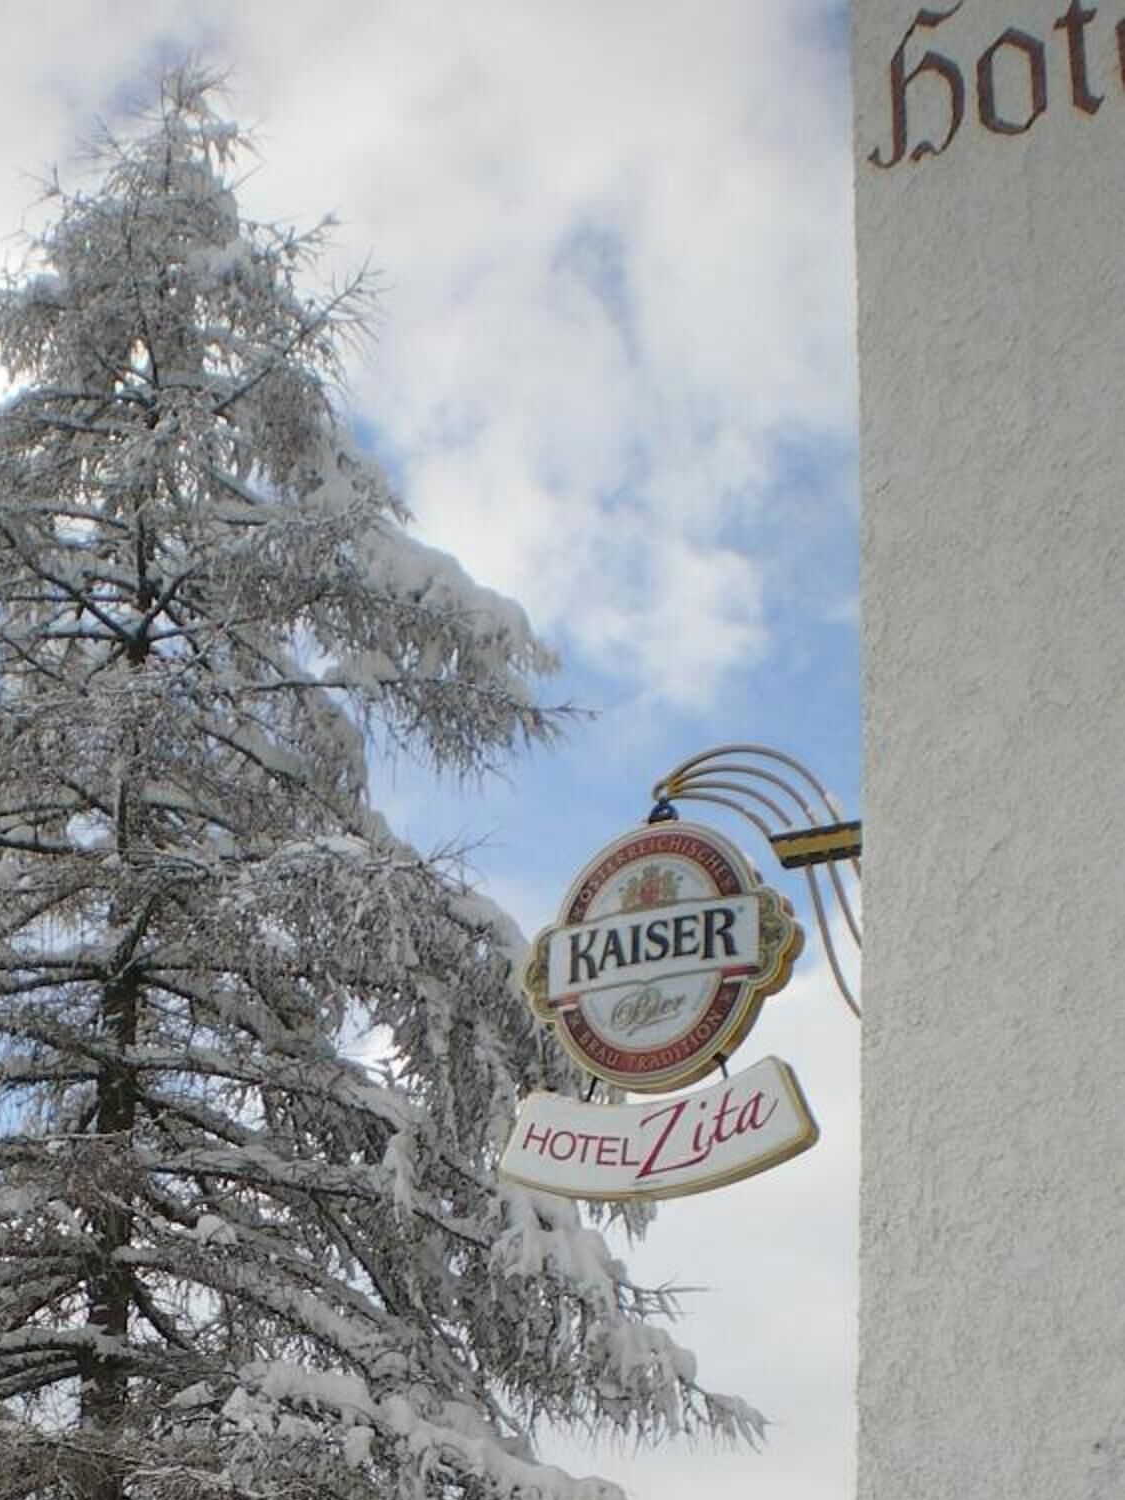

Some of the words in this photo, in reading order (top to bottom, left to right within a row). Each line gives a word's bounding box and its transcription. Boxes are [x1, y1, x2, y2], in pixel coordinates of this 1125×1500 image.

[867, 0, 1125, 168] Hot
[568, 907, 738, 984] KAISER
[523, 1123, 639, 1166] HOTEL
[635, 1087, 778, 1179] Zita
